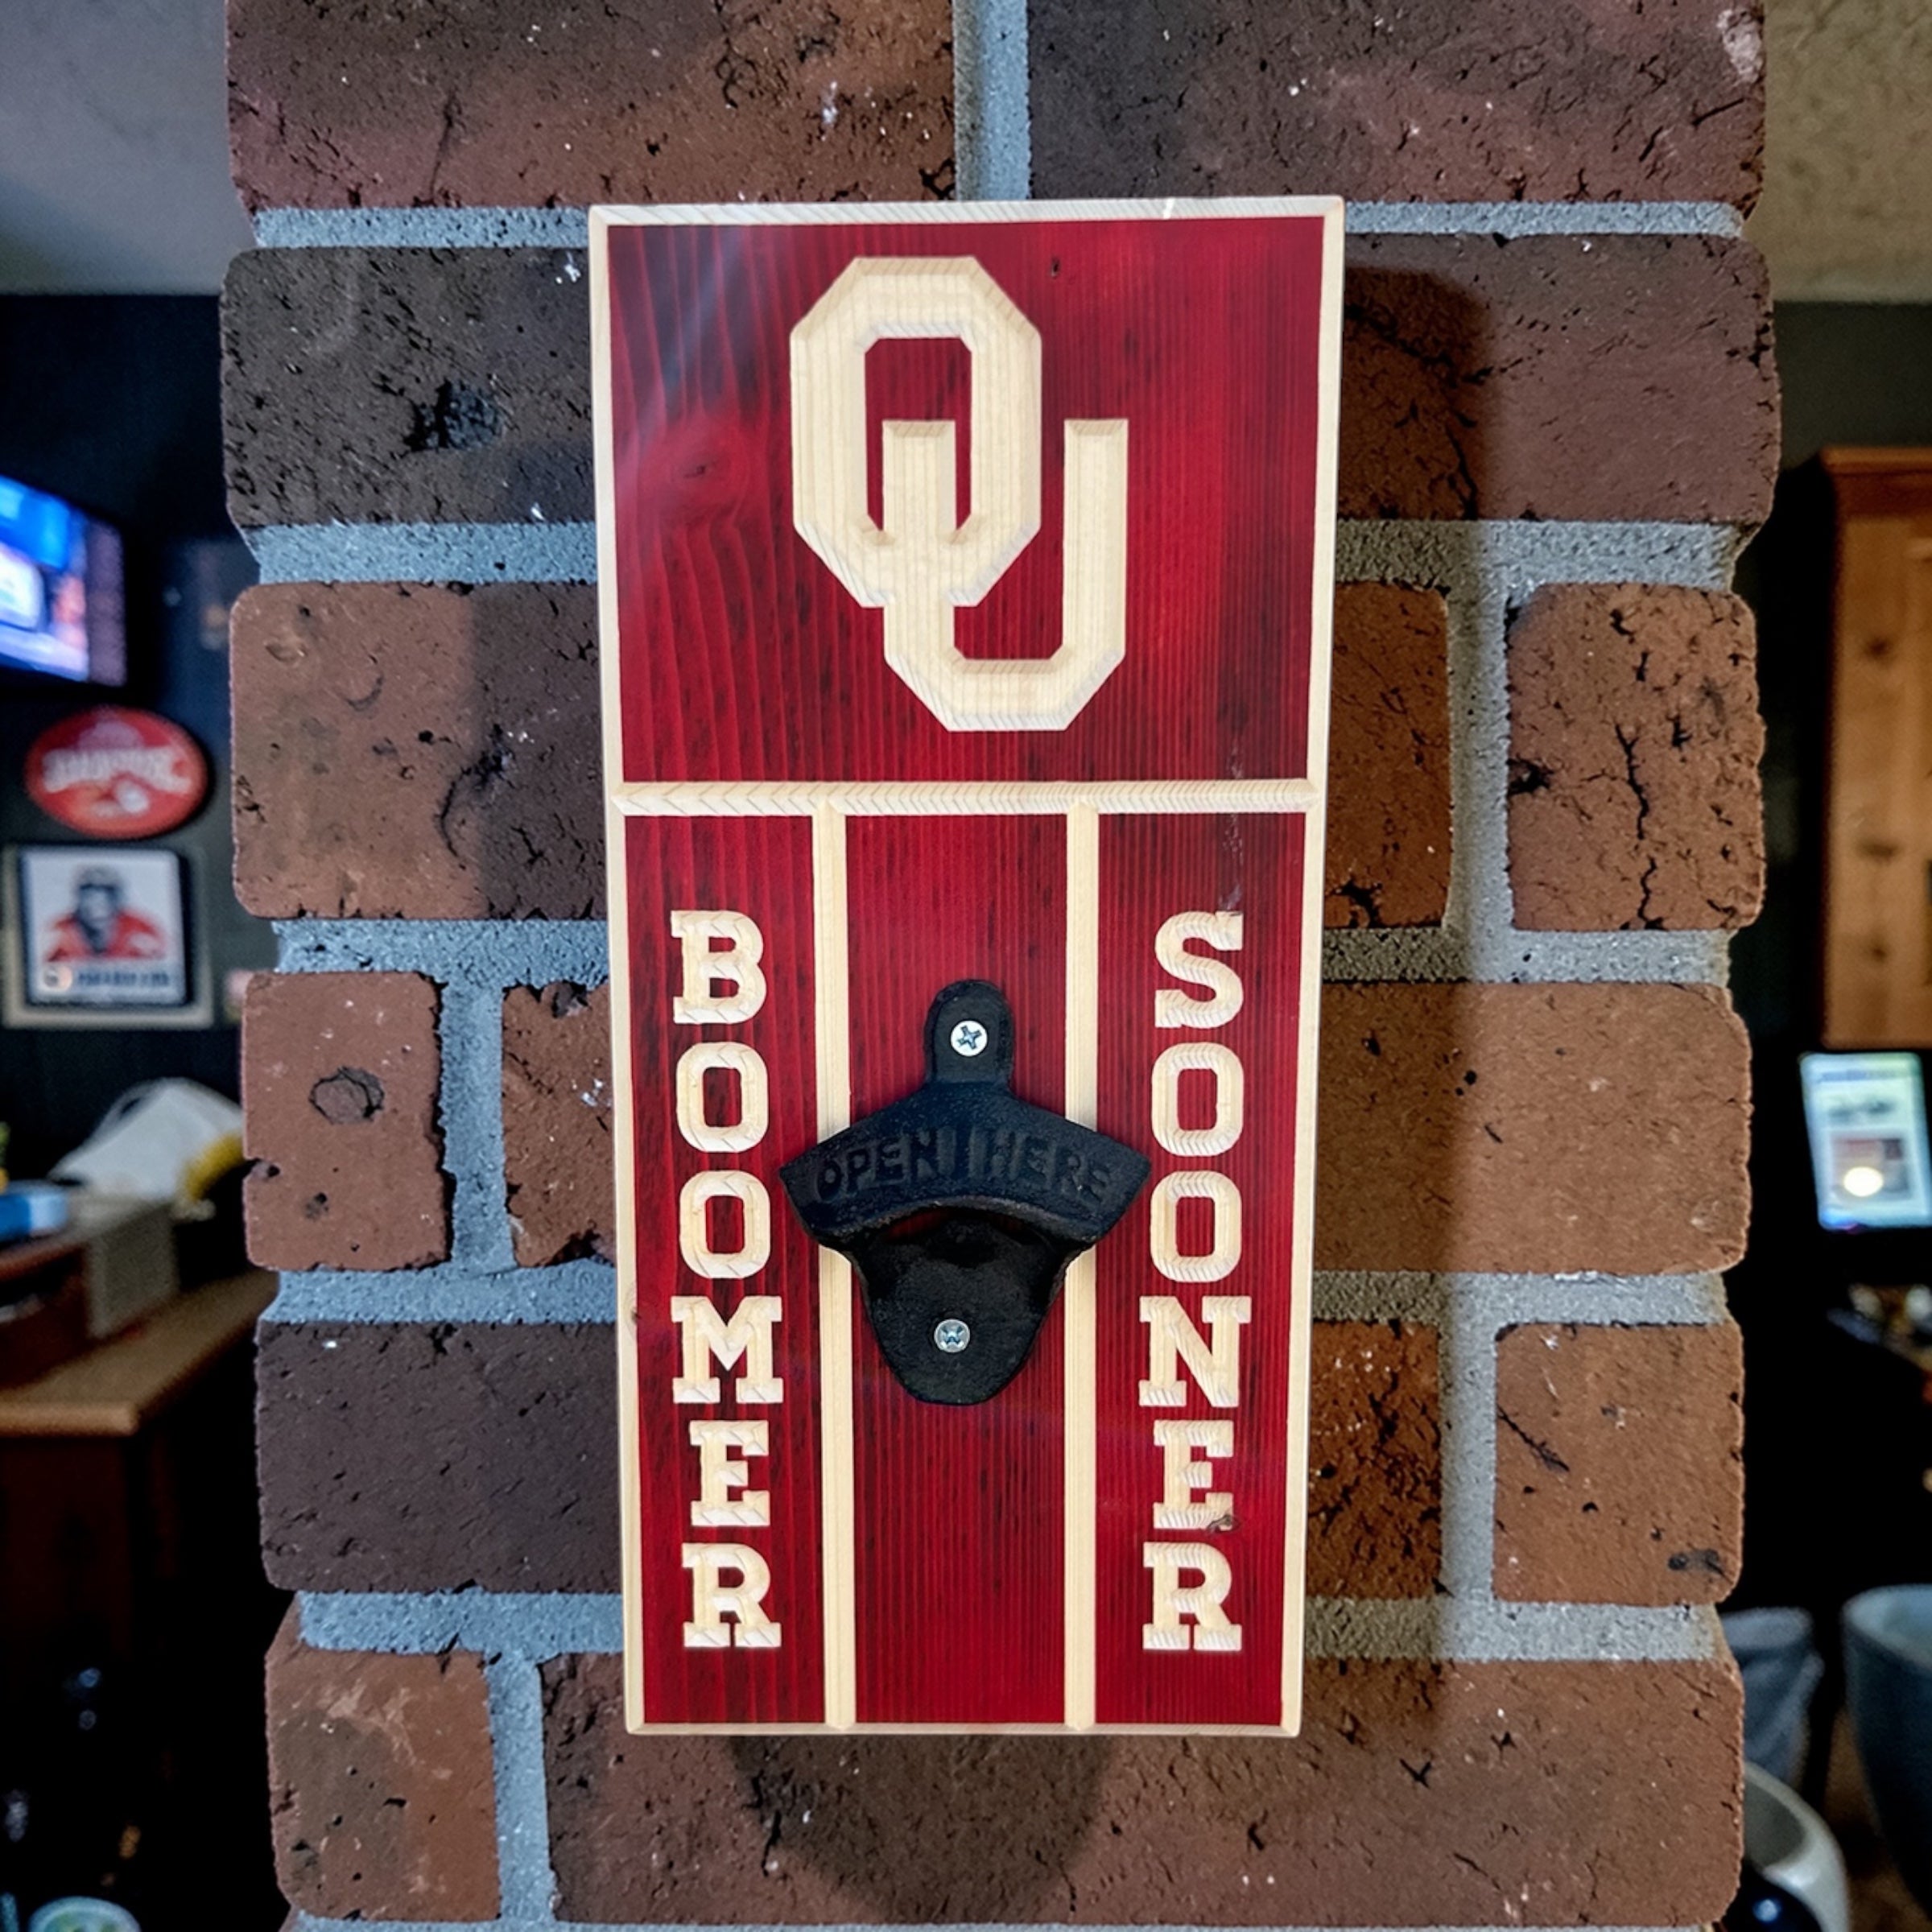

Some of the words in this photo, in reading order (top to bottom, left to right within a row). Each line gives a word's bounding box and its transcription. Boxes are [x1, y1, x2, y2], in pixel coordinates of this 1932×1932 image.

[789, 256, 1129, 732] OU
[670, 910, 783, 1649] BOOMER
[815, 1125, 957, 1203] OPEN
[967, 1126, 1114, 1206] HERE
[1138, 910, 1252, 1652] SOONER
